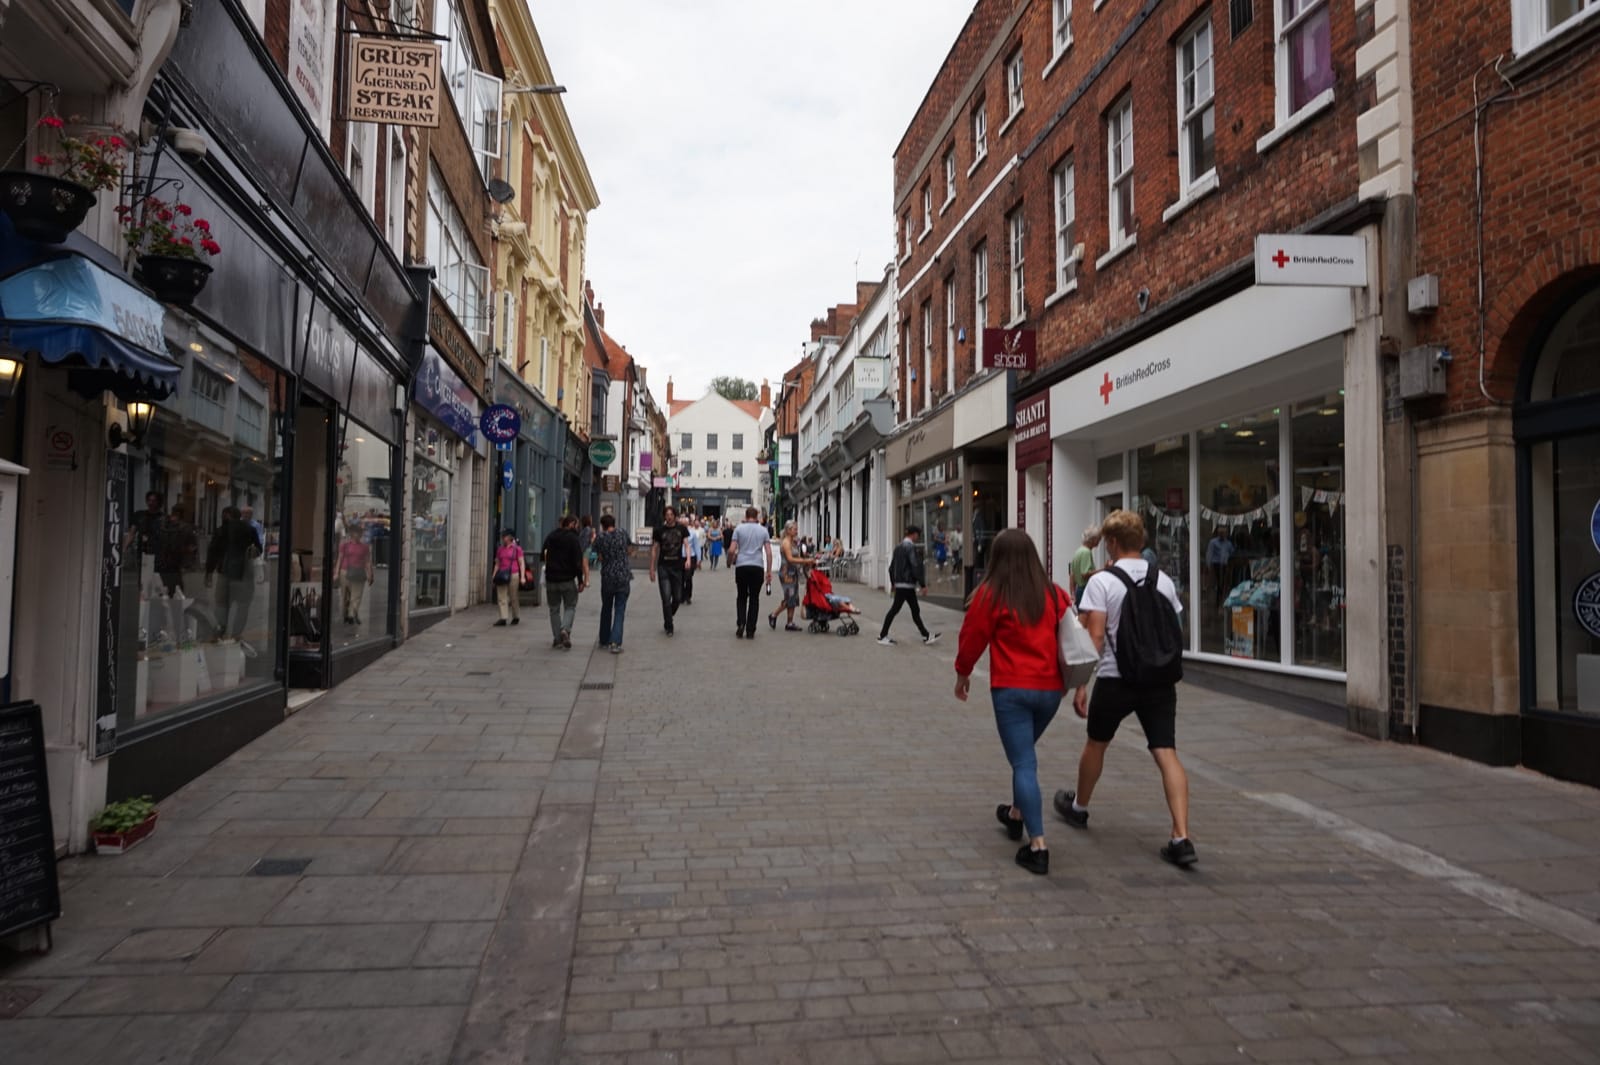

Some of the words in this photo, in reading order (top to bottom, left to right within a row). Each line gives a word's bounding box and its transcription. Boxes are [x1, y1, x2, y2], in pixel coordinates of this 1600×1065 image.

[360, 47, 434, 68] CRUST
[377, 66, 416, 79] FULLY
[364, 77, 427, 92] LICENSED
[357, 90, 434, 110] STEAK
[354, 107, 435, 123] RESTAURANT
[1293, 256, 1354, 265] BritishRedCross
[1116, 358, 1171, 389] BritishRedCross
[1016, 399, 1046, 429] SHANTI
[106, 479, 121, 588] CRUST
